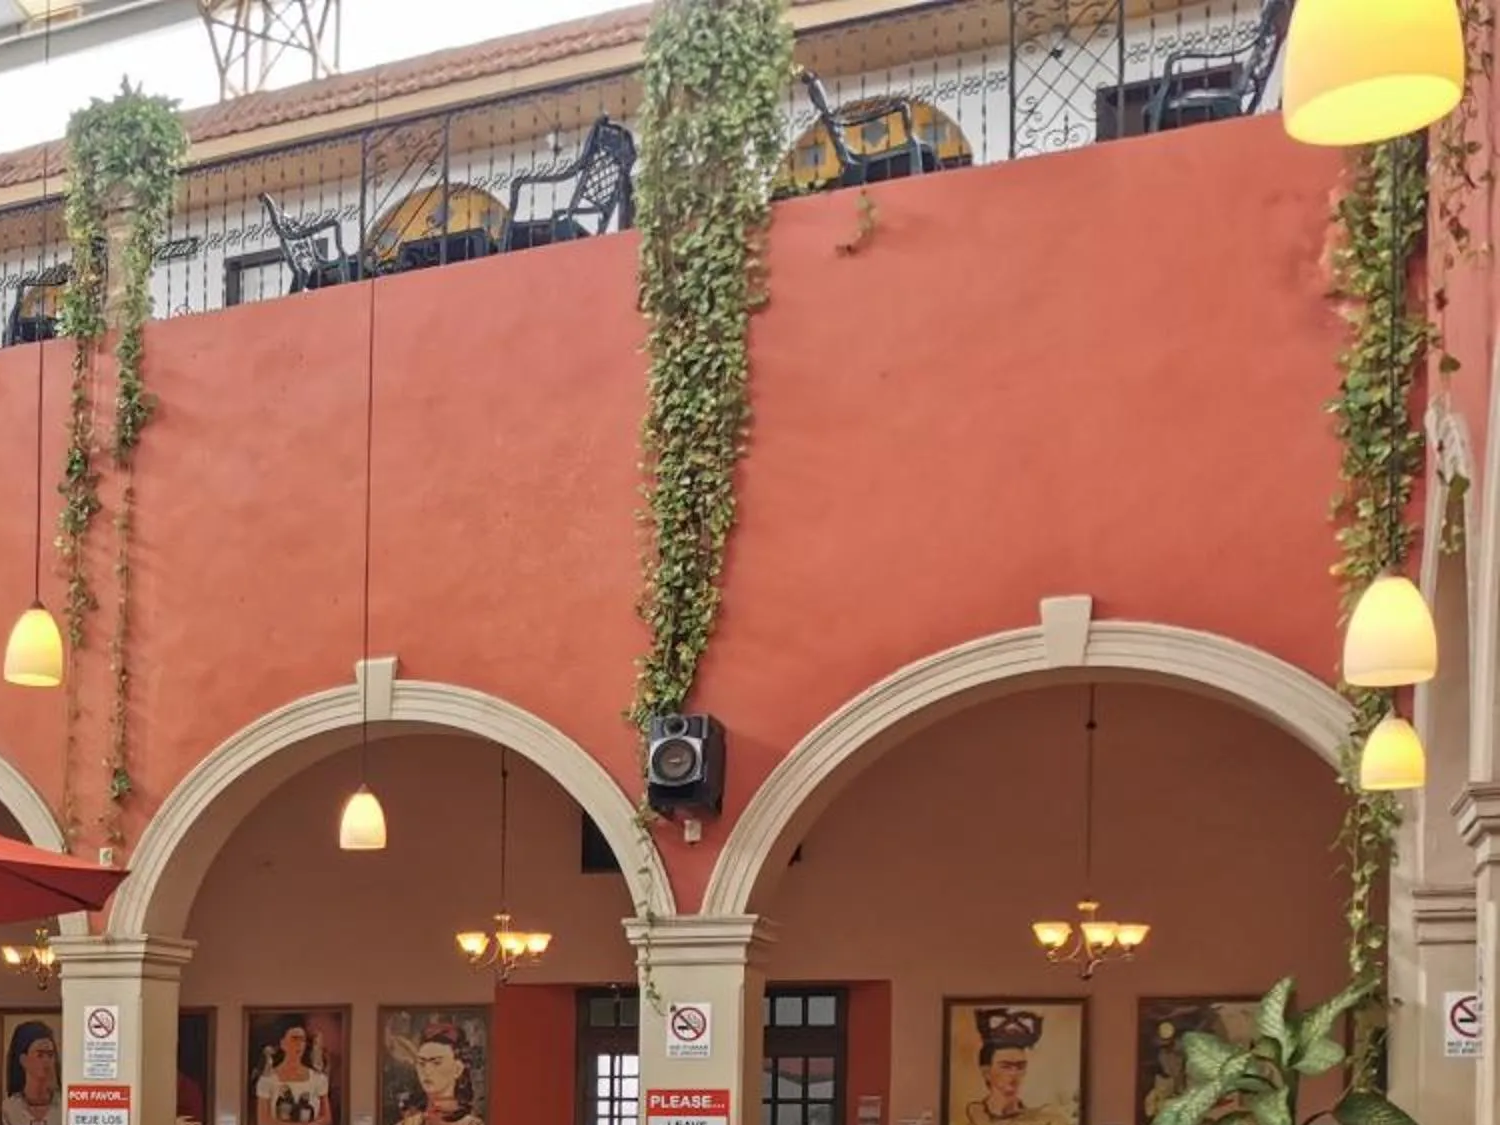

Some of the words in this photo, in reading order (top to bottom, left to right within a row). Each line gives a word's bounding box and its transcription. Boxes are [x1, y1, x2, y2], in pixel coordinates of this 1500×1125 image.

[69, 1091, 88, 1101] POR
[650, 1095, 725, 1108] PLEASE...
[75, 1115, 99, 1125] DEJE
[102, 1115, 122, 1125] LOS
